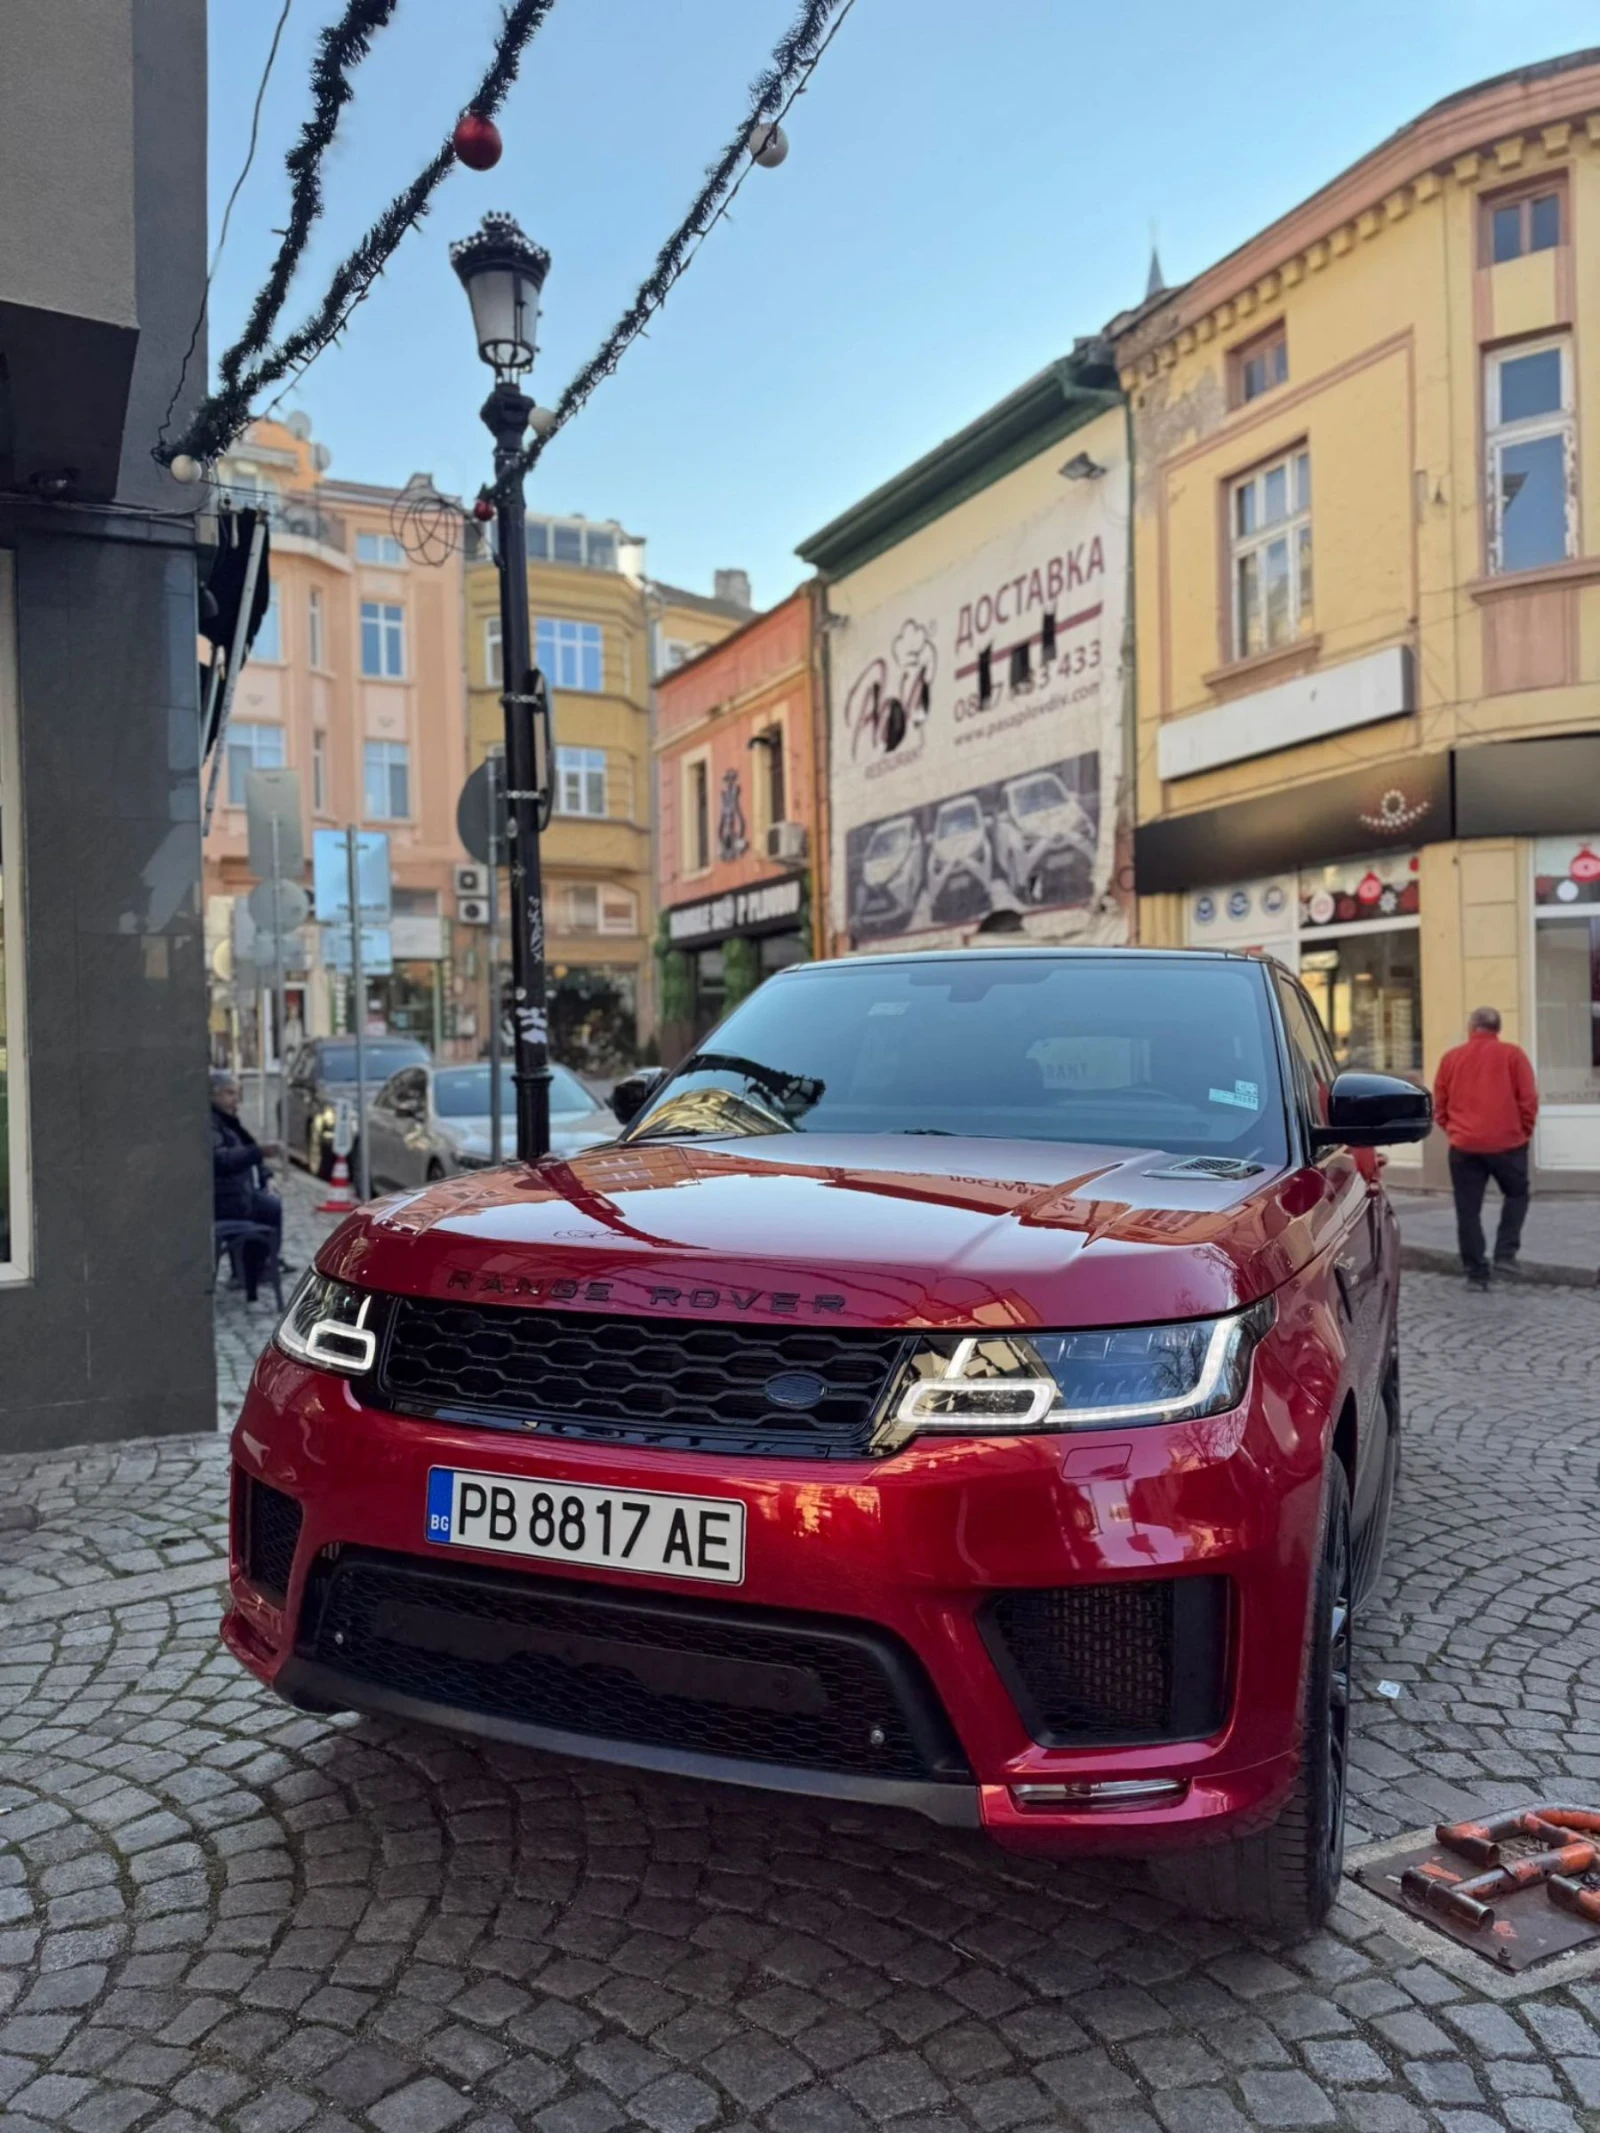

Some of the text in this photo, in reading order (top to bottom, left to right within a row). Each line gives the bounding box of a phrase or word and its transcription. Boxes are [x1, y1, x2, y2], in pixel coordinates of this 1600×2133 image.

[955, 535, 1105, 656] ДОСТАВКА
[1057, 640, 1101, 679] 433
[447, 1270, 847, 1314] RANGE ROVER
[431, 1514, 449, 1532] BG
[458, 1482, 731, 1571] PB 8817 AE
